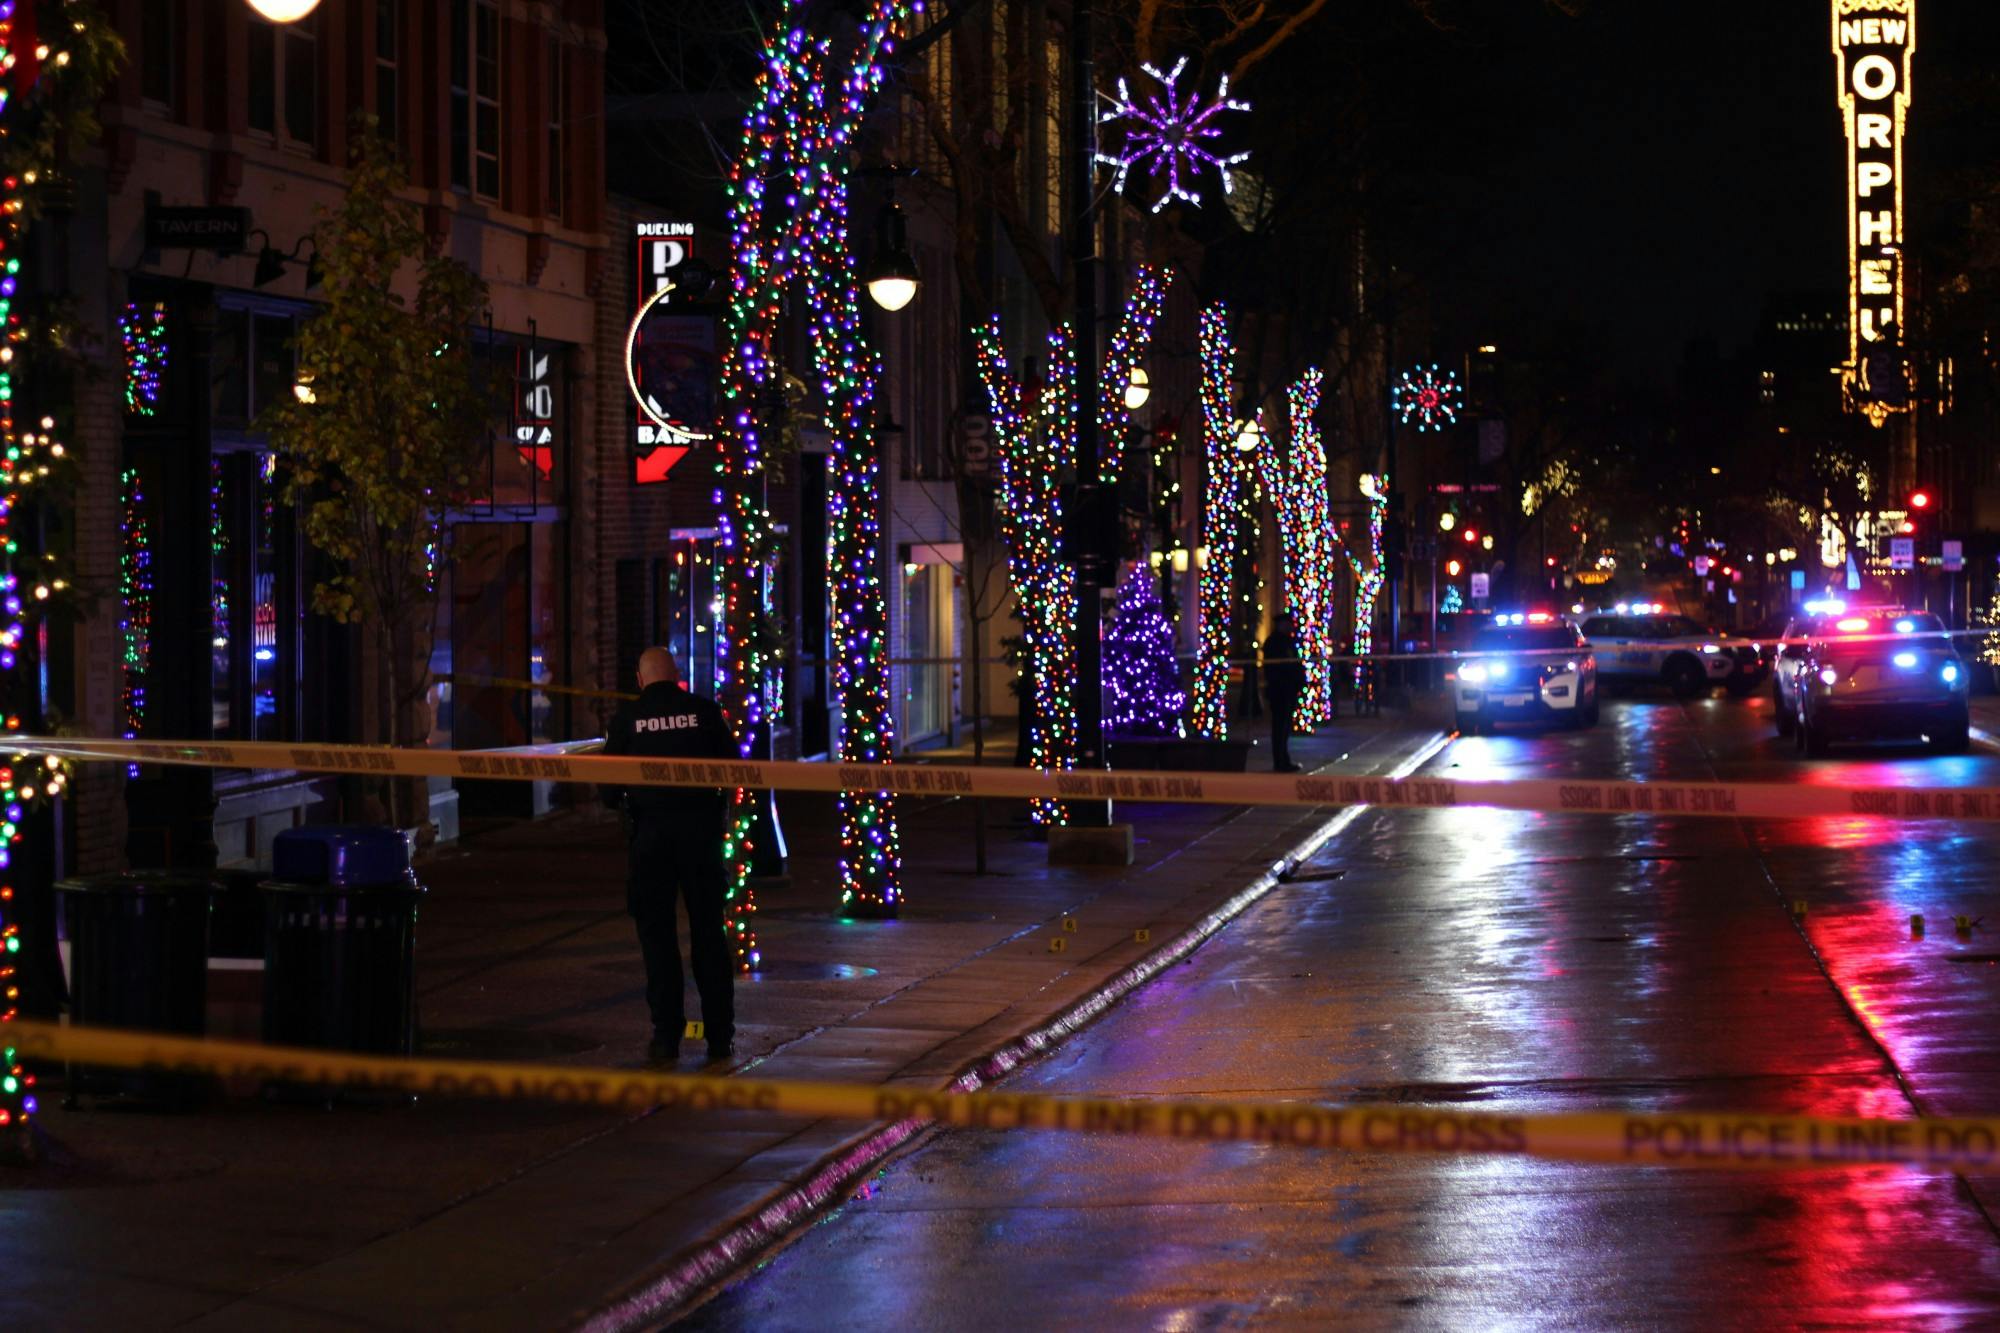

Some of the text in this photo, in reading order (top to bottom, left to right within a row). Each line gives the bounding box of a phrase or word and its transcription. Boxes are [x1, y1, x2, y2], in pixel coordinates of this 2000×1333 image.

[1841, 18, 1907, 46] NEW
[155, 218, 240, 234] TAVERN
[637, 222, 695, 236] DUELING
[1852, 54, 1897, 393] ORPHEU
[635, 714, 699, 733] POLICE
[1559, 785, 1737, 812] POLICE LINE DO NOT CROSS
[1852, 791, 1898, 815] CROSS
[1170, 1104, 1240, 1142] DO
[1253, 1108, 1344, 1146] NOT
[1358, 1110, 1528, 1152] CROSS
[1621, 1117, 1998, 1169] POLICE LINE DO
